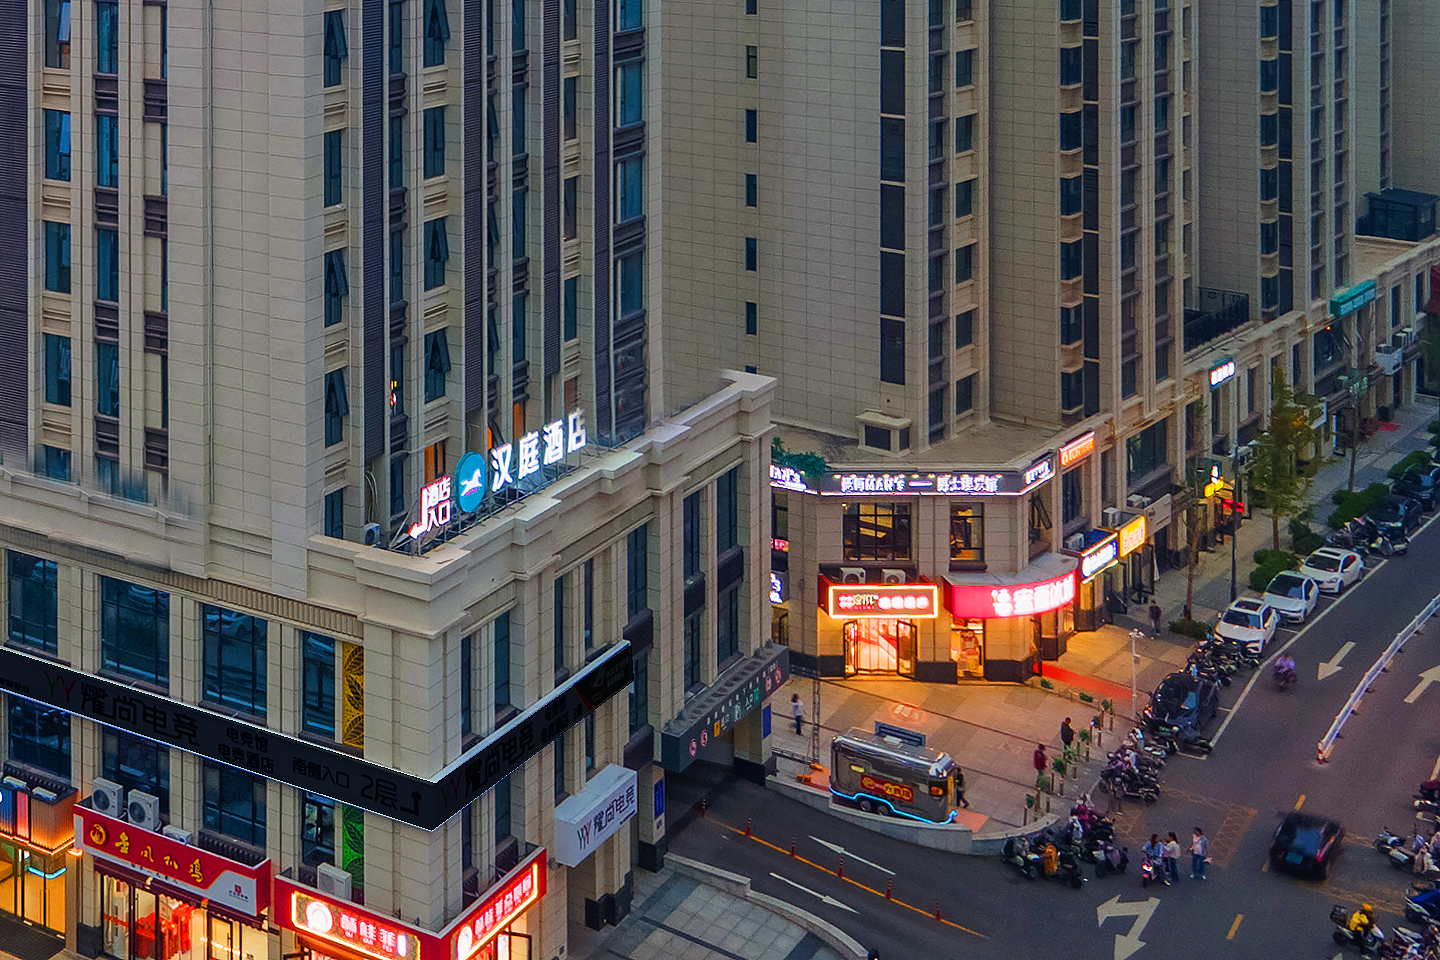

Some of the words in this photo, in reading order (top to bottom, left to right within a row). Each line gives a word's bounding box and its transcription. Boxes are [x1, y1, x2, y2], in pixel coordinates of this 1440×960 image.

[492, 407, 587, 492] 汉庭酒店
[427, 476, 451, 507] 酒店
[427, 500, 451, 532] 入口
[292, 757, 350, 789] 南侧入口
[361, 774, 398, 810] 2层
